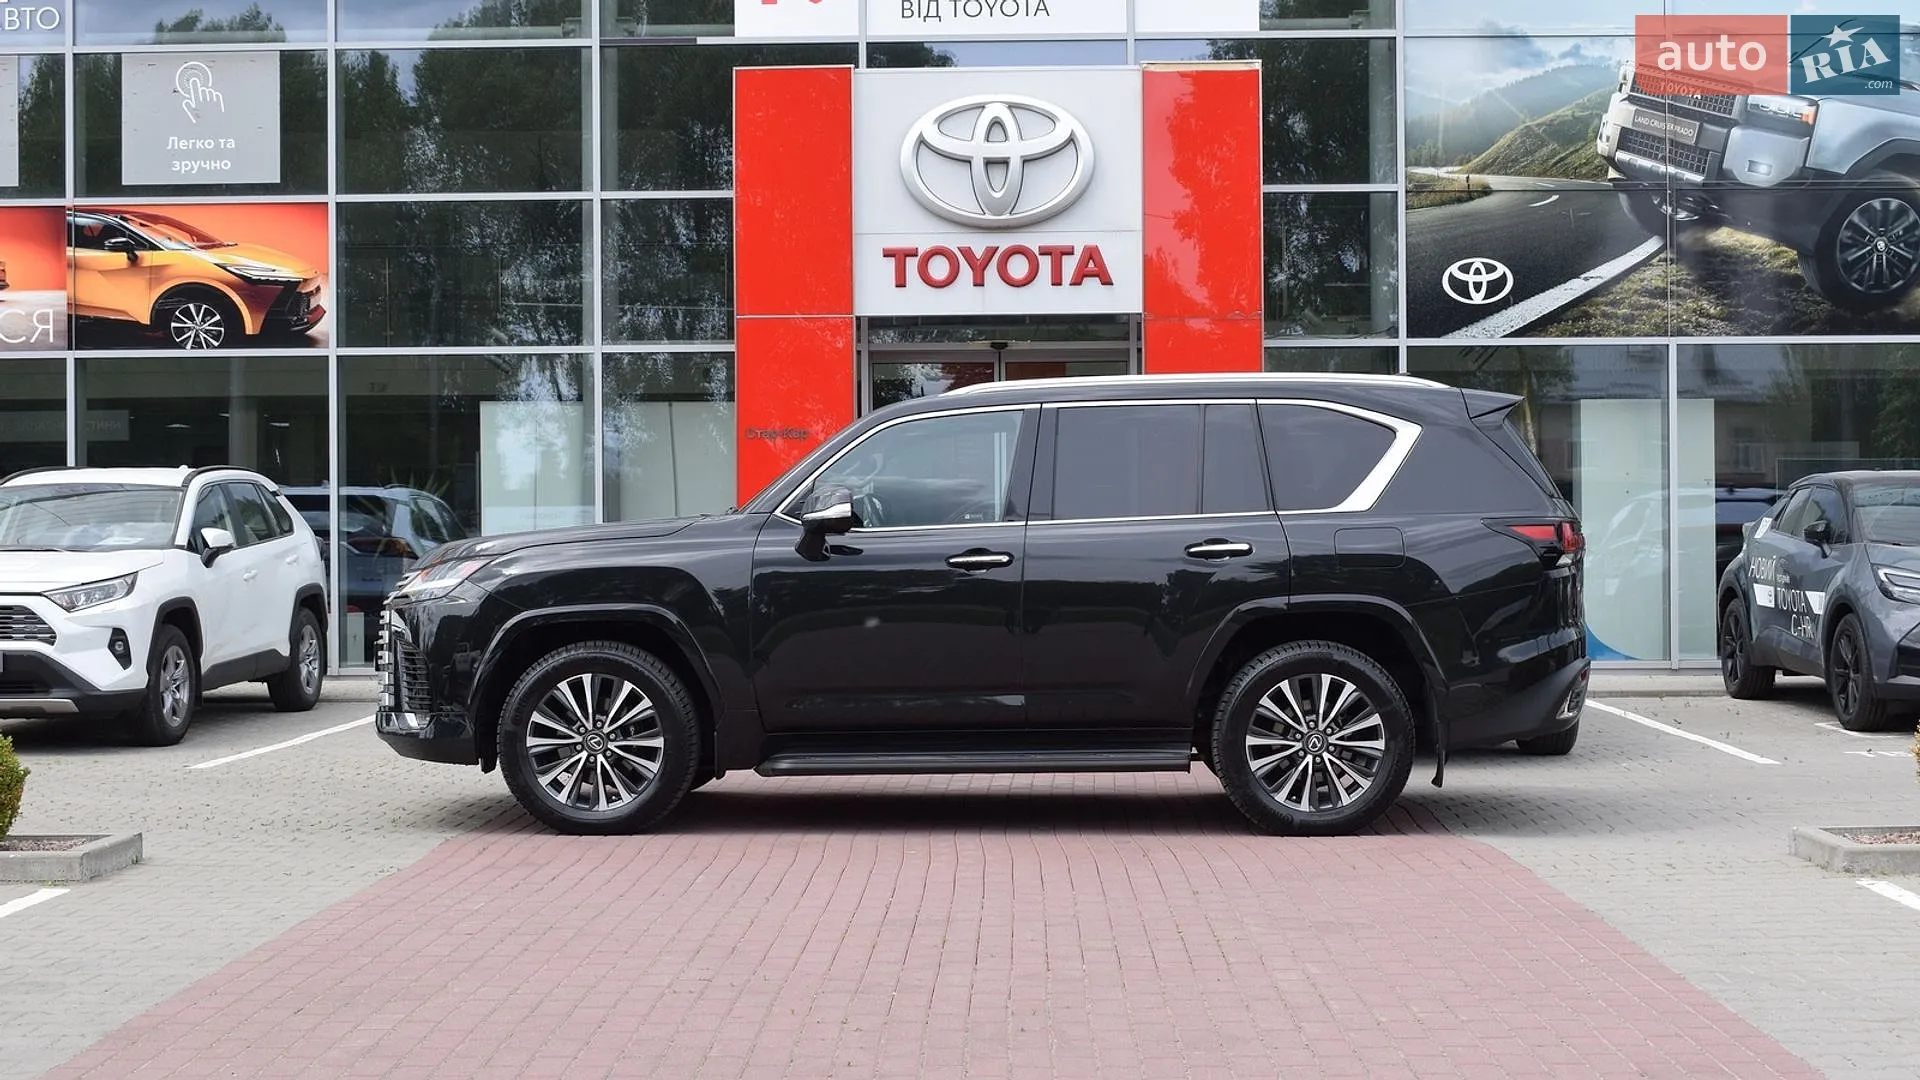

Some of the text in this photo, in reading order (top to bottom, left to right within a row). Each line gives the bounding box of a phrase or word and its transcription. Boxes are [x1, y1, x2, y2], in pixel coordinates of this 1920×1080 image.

[0, 7, 60, 30] ВТО
[901, 0, 1050, 22] ВІД TOYOTA
[1659, 82, 1701, 99] TOYOTA
[166, 136, 235, 150] Легко та
[172, 159, 231, 174] зручно
[882, 244, 1114, 288] TOYOTA
[1748, 555, 1777, 580] НОВИЙ
[1776, 587, 1807, 612] TOYOTA
[1791, 614, 1814, 639] C-HR
